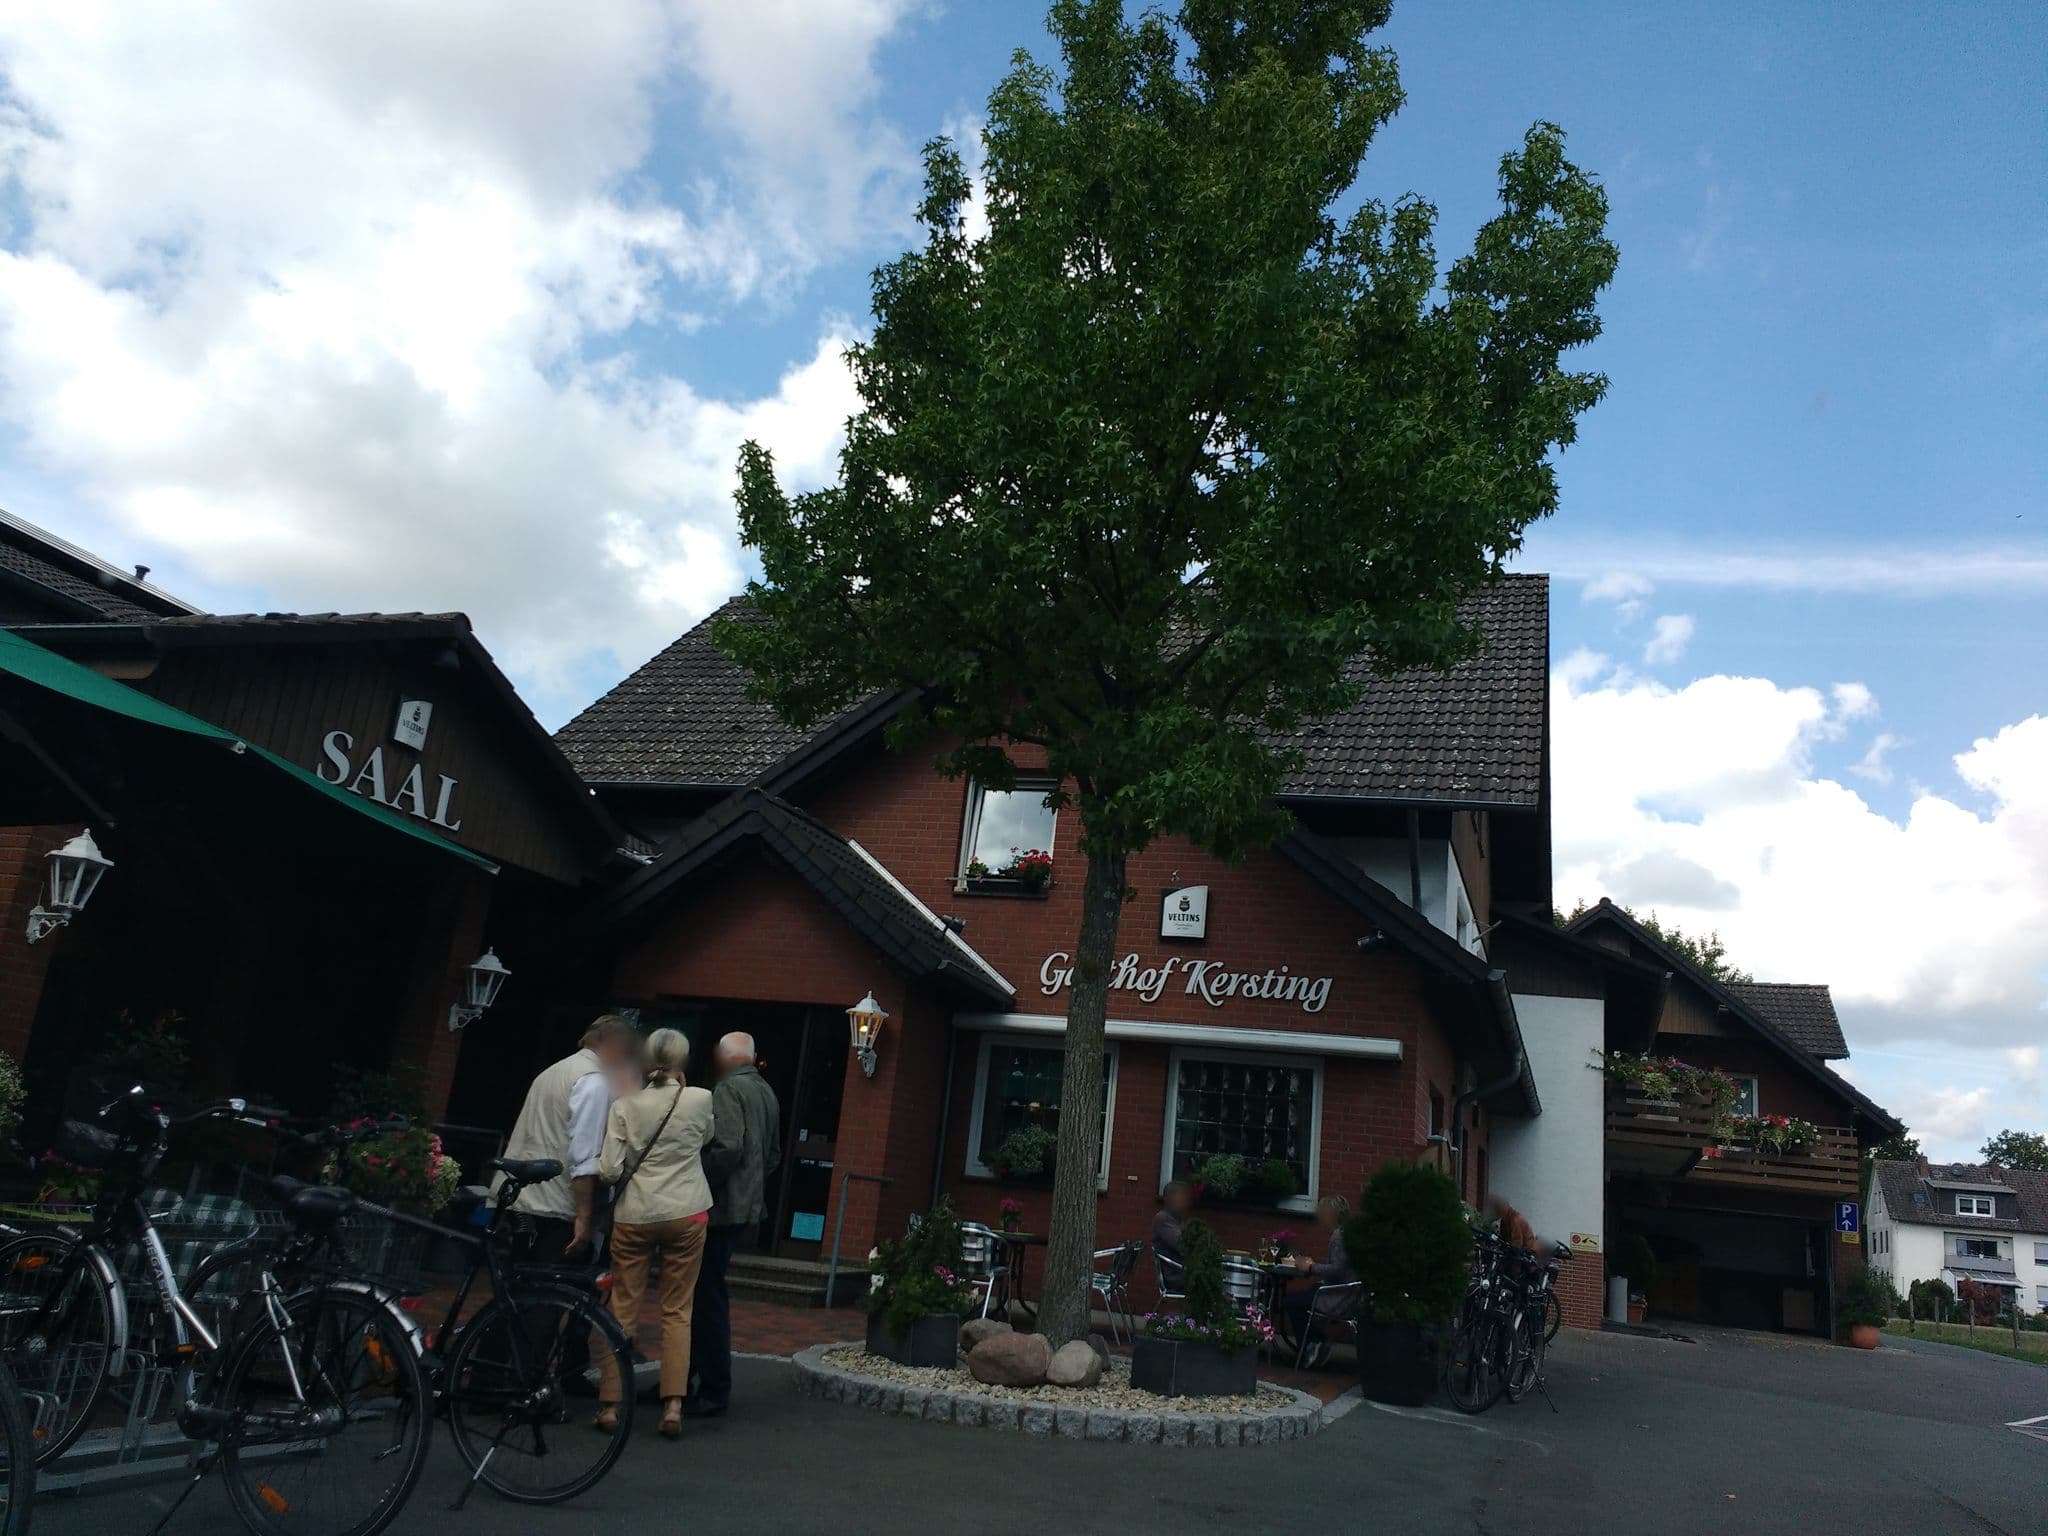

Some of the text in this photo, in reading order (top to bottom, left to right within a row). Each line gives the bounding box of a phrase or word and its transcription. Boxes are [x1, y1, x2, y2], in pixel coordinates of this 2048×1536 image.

[316, 730, 462, 832] SAAL
[1168, 913, 1201, 922] VELTINS
[1039, 951, 1334, 1013] Ghof Kersting
[1842, 1204, 1852, 1218] P
